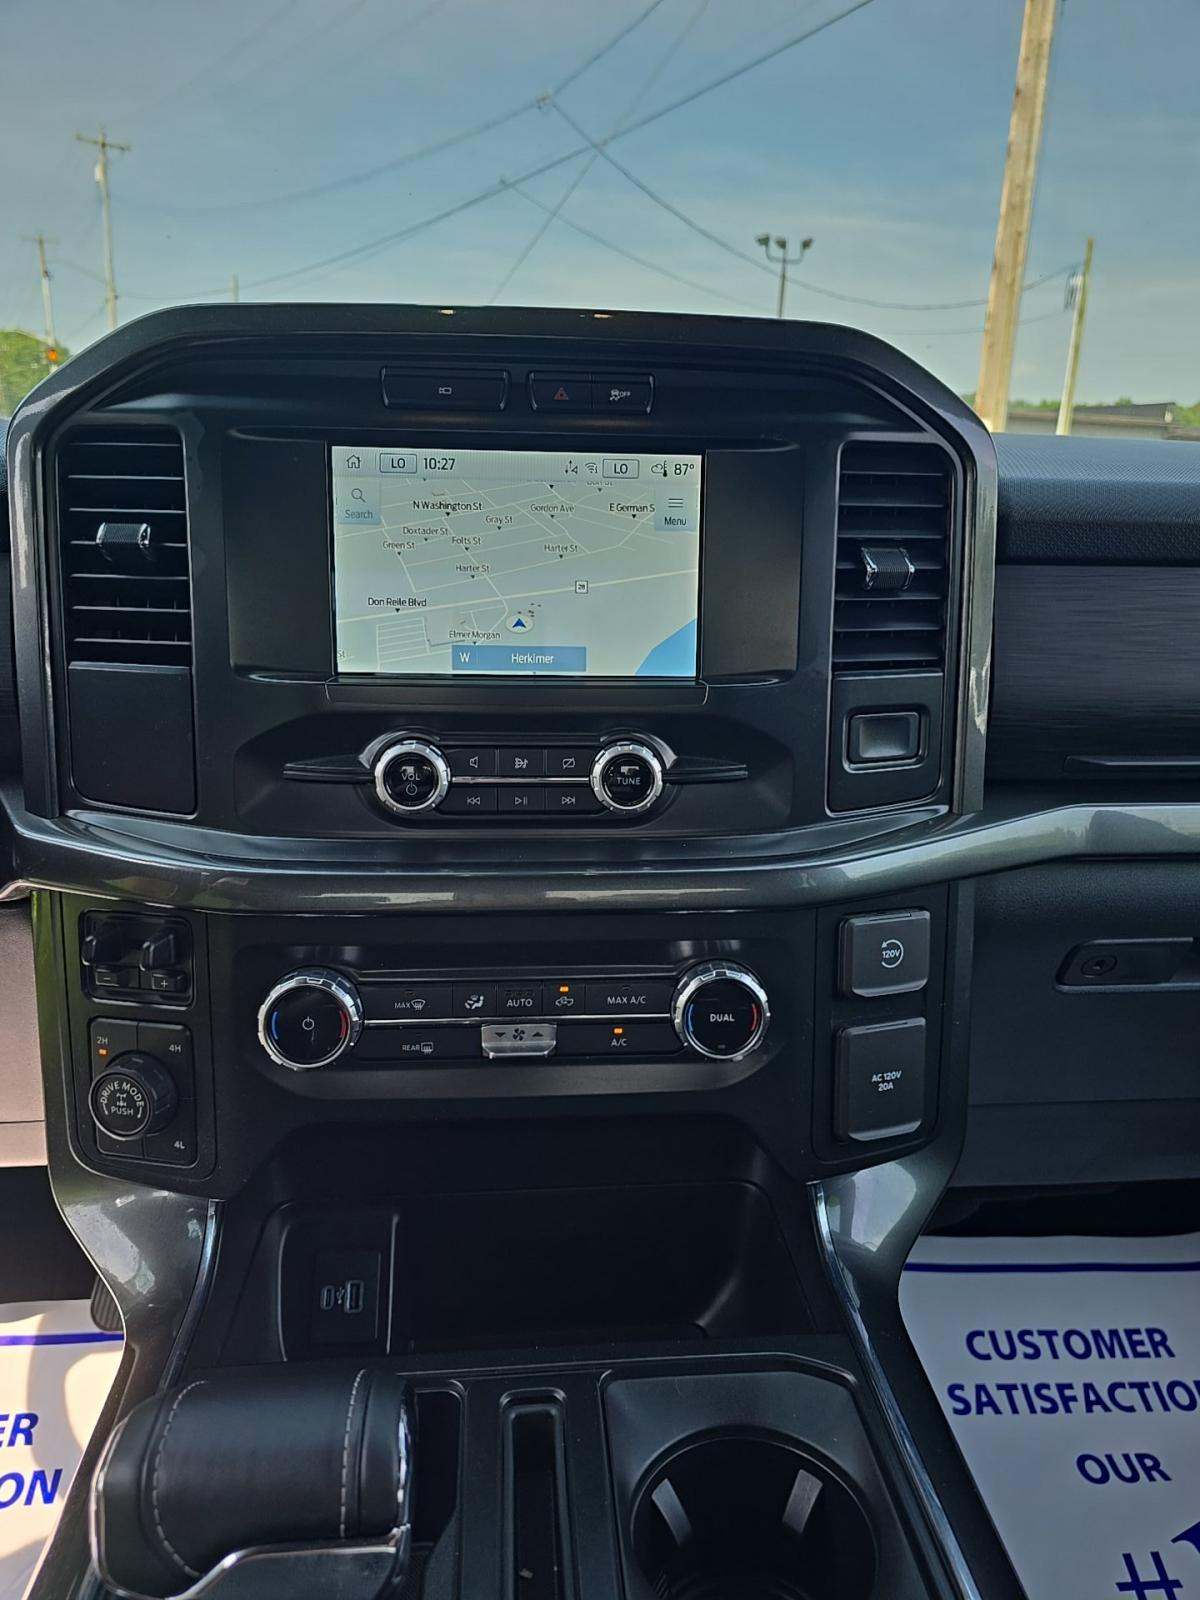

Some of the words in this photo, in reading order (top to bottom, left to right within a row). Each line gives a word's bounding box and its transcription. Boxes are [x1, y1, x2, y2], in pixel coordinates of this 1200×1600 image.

[391, 457, 406, 469] LO
[424, 457, 456, 471] 10:27
[613, 463, 628, 475] LO
[413, 501, 420, 509] N
[421, 500, 472, 512] Washington
[472, 502, 482, 510] St
[530, 504, 559, 512] Gordon
[560, 504, 575, 512] Ave
[609, 503, 615, 511] E
[616, 503, 648, 512] German
[345, 509, 373, 519] Search
[485, 515, 503, 525] Gray
[664, 516, 687, 526] Menu
[402, 527, 438, 535] Doxtader
[383, 541, 405, 549] Green
[406, 541, 415, 549] St
[452, 536, 471, 545] Folts
[472, 537, 481, 545] St
[544, 544, 568, 552] Harter
[456, 564, 480, 572] Harter
[368, 597, 385, 606] Don
[408, 598, 427, 607] Blvd
[449, 630, 471, 638] Elmer
[472, 631, 501, 640] Morgan
[459, 652, 471, 663] W
[511, 653, 555, 664] Herkimer
[616, 777, 641, 785] TUNE
[882, 949, 900, 959] 120V
[506, 999, 533, 1007] AUTO
[607, 996, 628, 1004] MAX
[630, 995, 647, 1004] A/C
[394, 1001, 411, 1009] MAX
[709, 1014, 735, 1022] DUAL
[97, 1036, 108, 1044] 2H
[610, 1038, 627, 1047] A/C
[169, 1044, 181, 1053] 4H
[872, 1073, 883, 1082] AC
[883, 1070, 902, 1080] 120V
[878, 1082, 894, 1091] 20A
[100, 1080, 120, 1104] DRIVE
[121, 1081, 144, 1107] MODE
[111, 1105, 134, 1115] PUSH
[174, 1140, 185, 1149] 4L
[965, 1327, 1176, 1361] CUSTOMER
[947, 1379, 1200, 1416] SATISFACTIO
[1076, 1452, 1172, 1485] OUR
